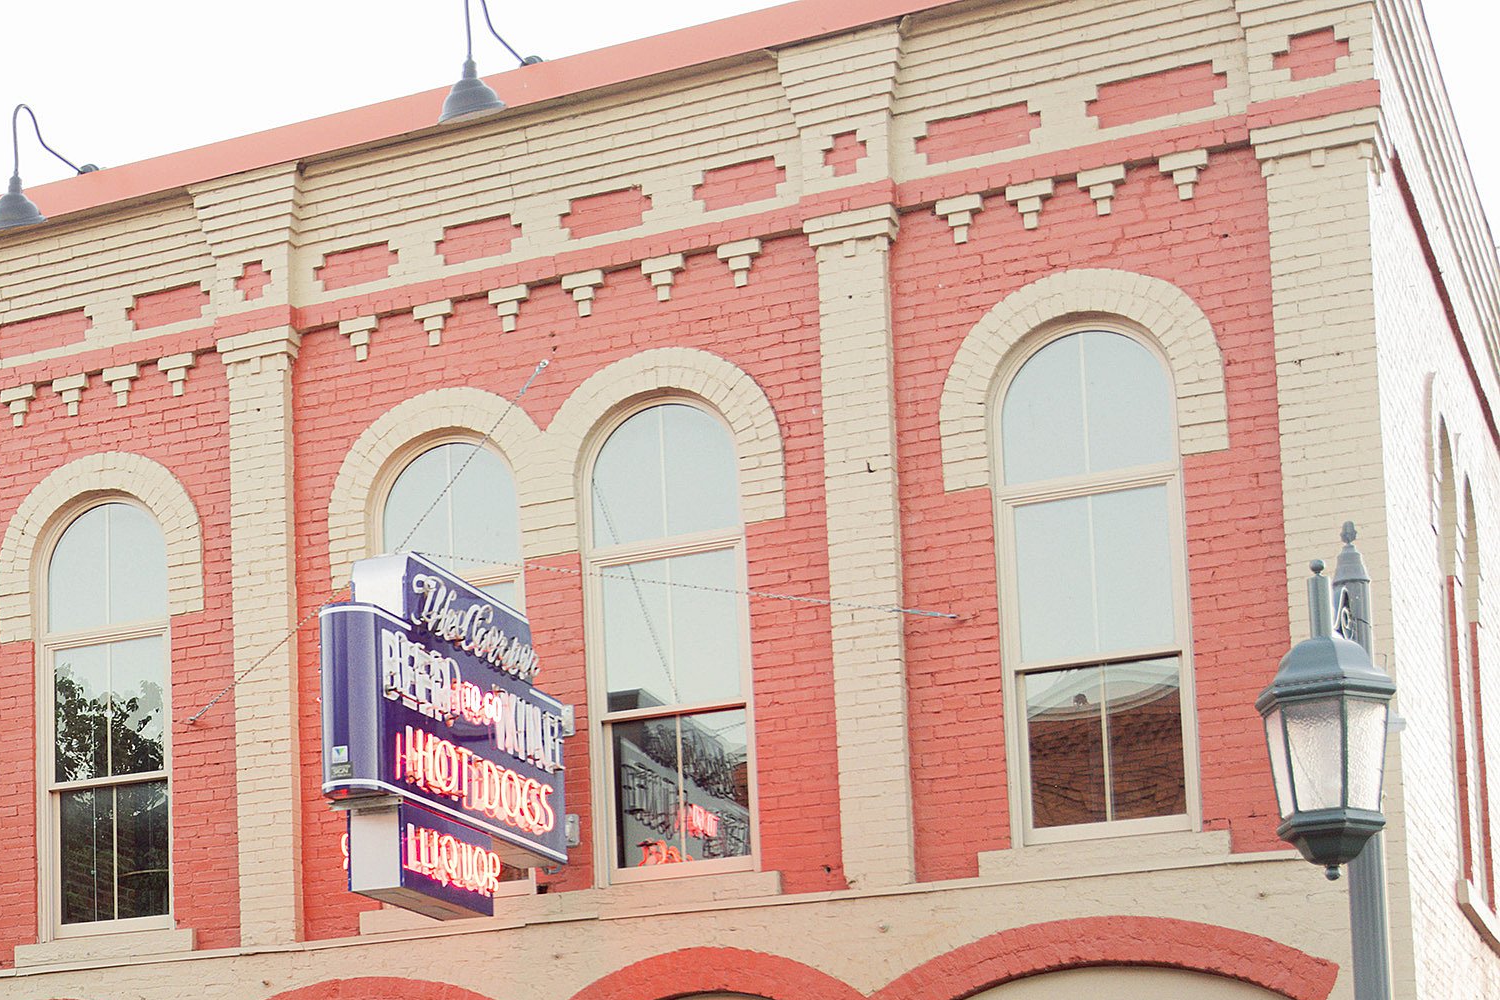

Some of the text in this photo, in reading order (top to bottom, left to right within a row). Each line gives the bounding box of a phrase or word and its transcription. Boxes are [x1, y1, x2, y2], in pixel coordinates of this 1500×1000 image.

[381, 627, 462, 722] BEER
[493, 684, 566, 775] WINE
[396, 724, 473, 802] HOT
[466, 756, 555, 836] DOGS
